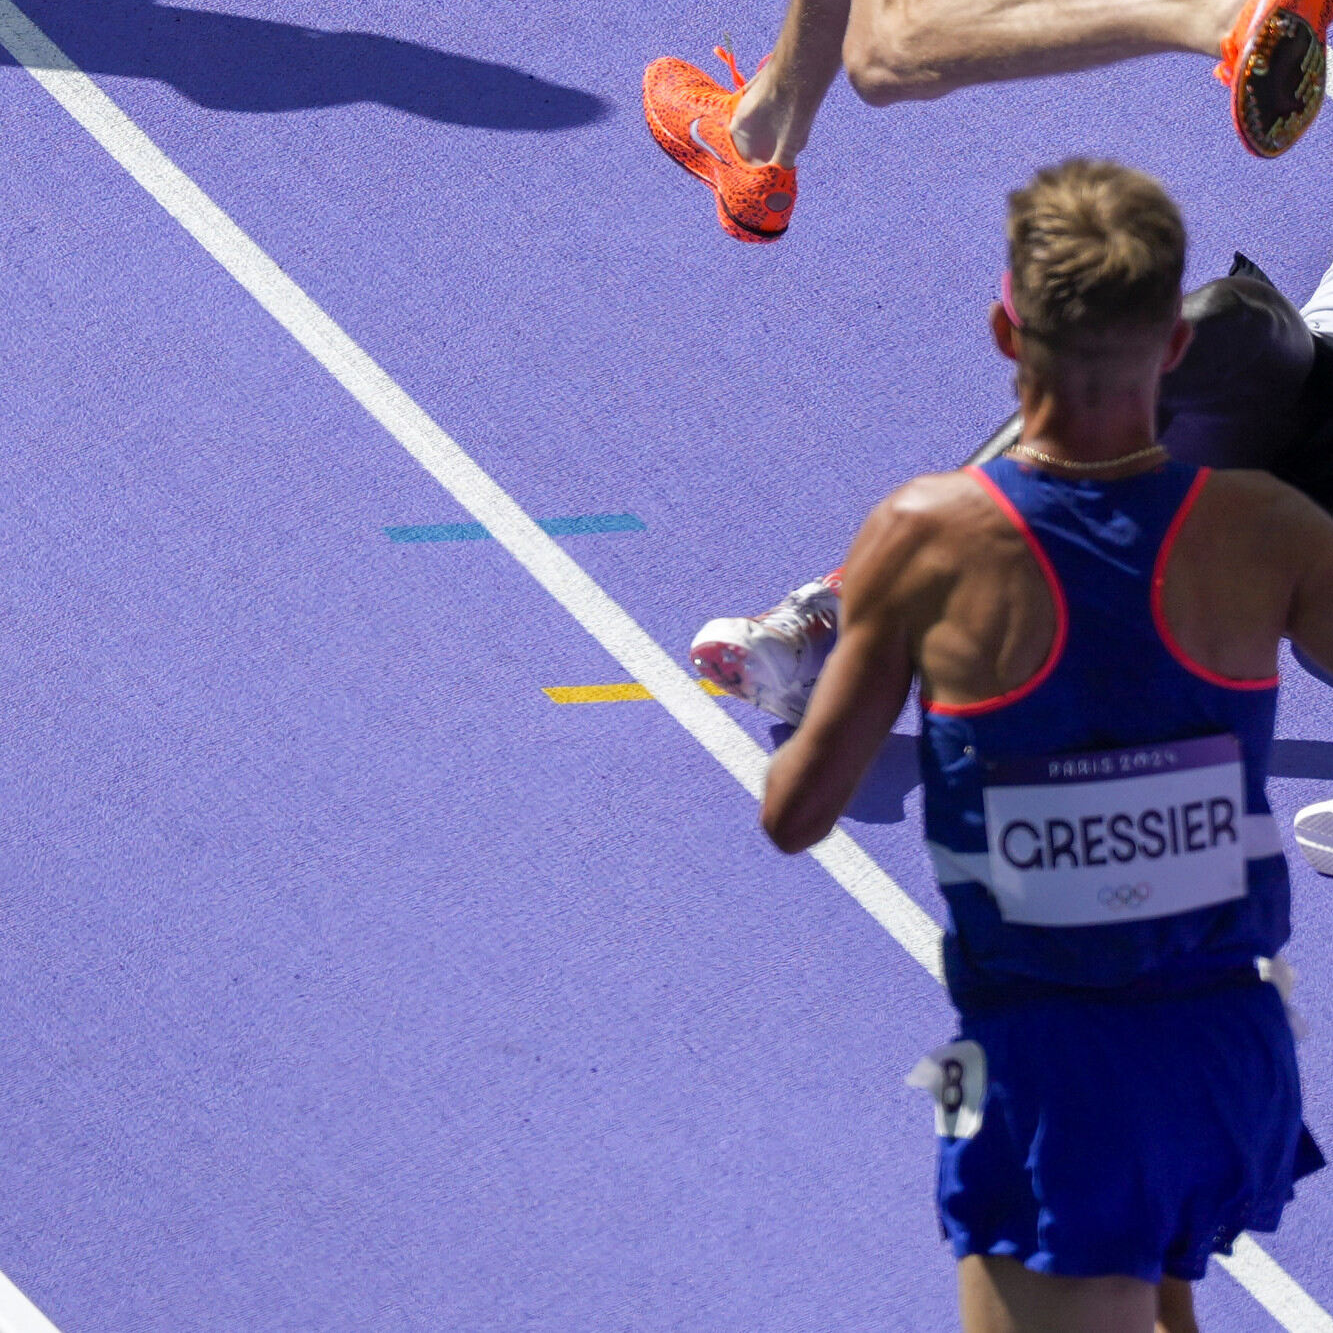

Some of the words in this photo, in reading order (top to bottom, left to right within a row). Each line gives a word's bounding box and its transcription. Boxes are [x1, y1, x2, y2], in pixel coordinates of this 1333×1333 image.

[1048, 760, 1114, 778] PARIS
[1119, 750, 1178, 772] 2024
[1001, 796, 1240, 872] GRESSIER
[940, 1060, 965, 1113] 8
